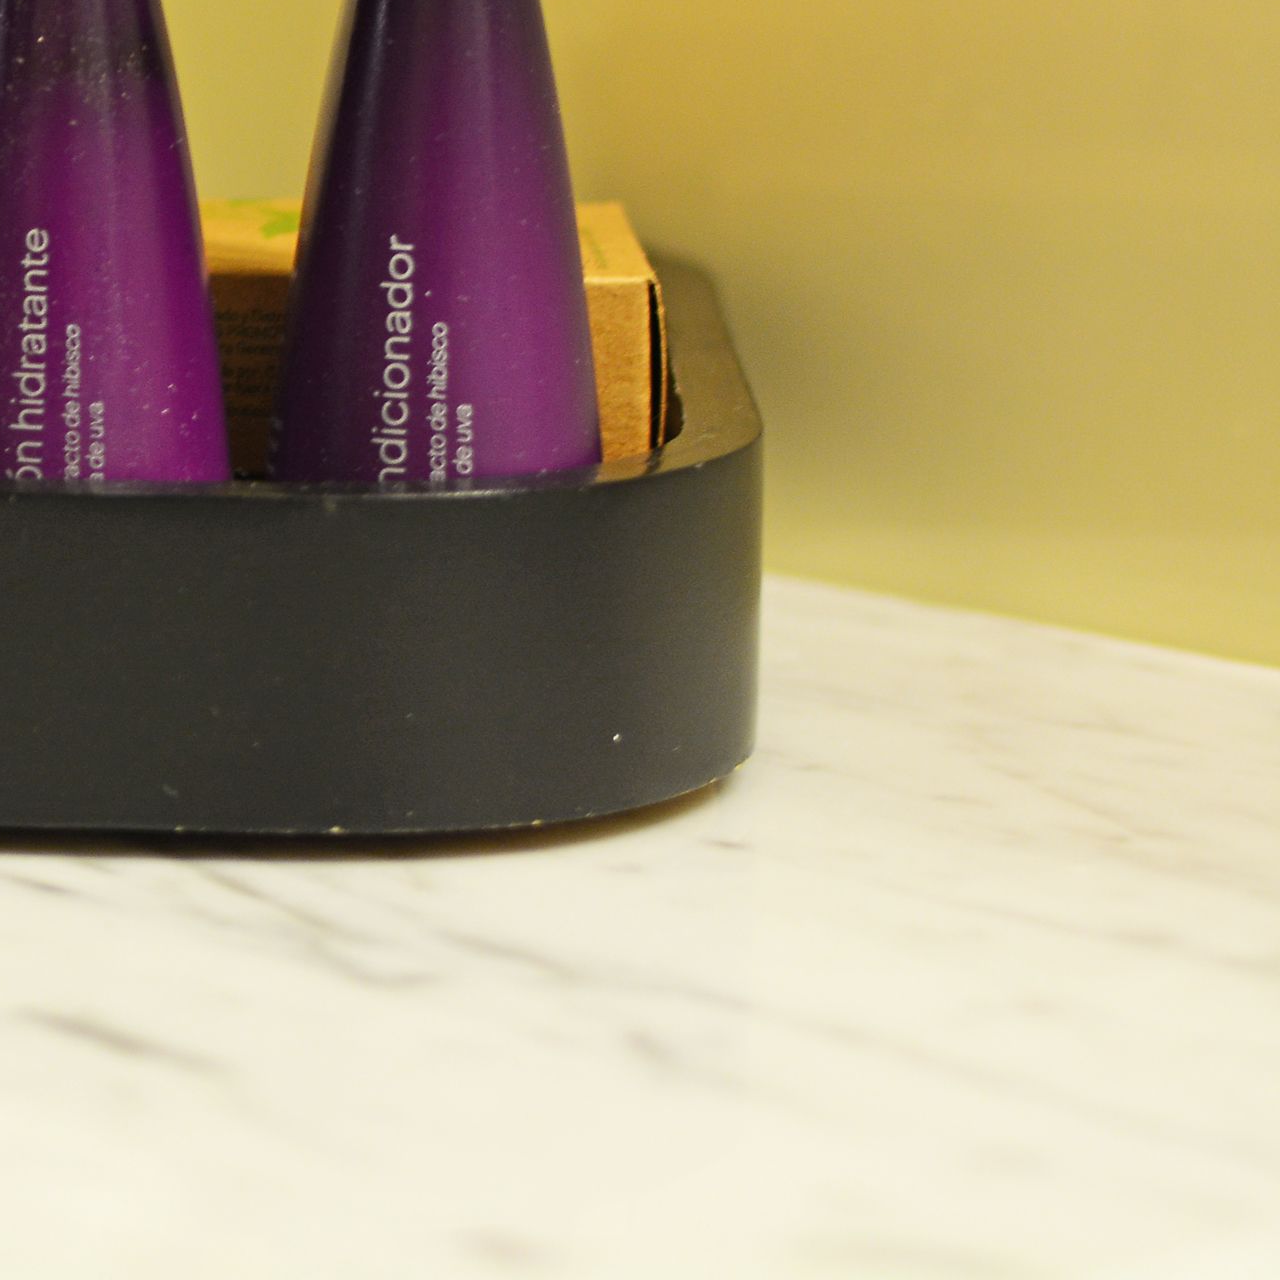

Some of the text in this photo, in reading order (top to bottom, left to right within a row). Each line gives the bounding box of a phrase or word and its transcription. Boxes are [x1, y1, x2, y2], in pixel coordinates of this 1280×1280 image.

[8, 228, 50, 431] hidratante
[62, 324, 81, 398] hibisco
[426, 322, 448, 400] hibisco
[62, 401, 81, 427] de
[89, 401, 105, 439] uva
[427, 402, 447, 431] de
[452, 403, 473, 474] de uva
[85, 442, 105, 468] de
